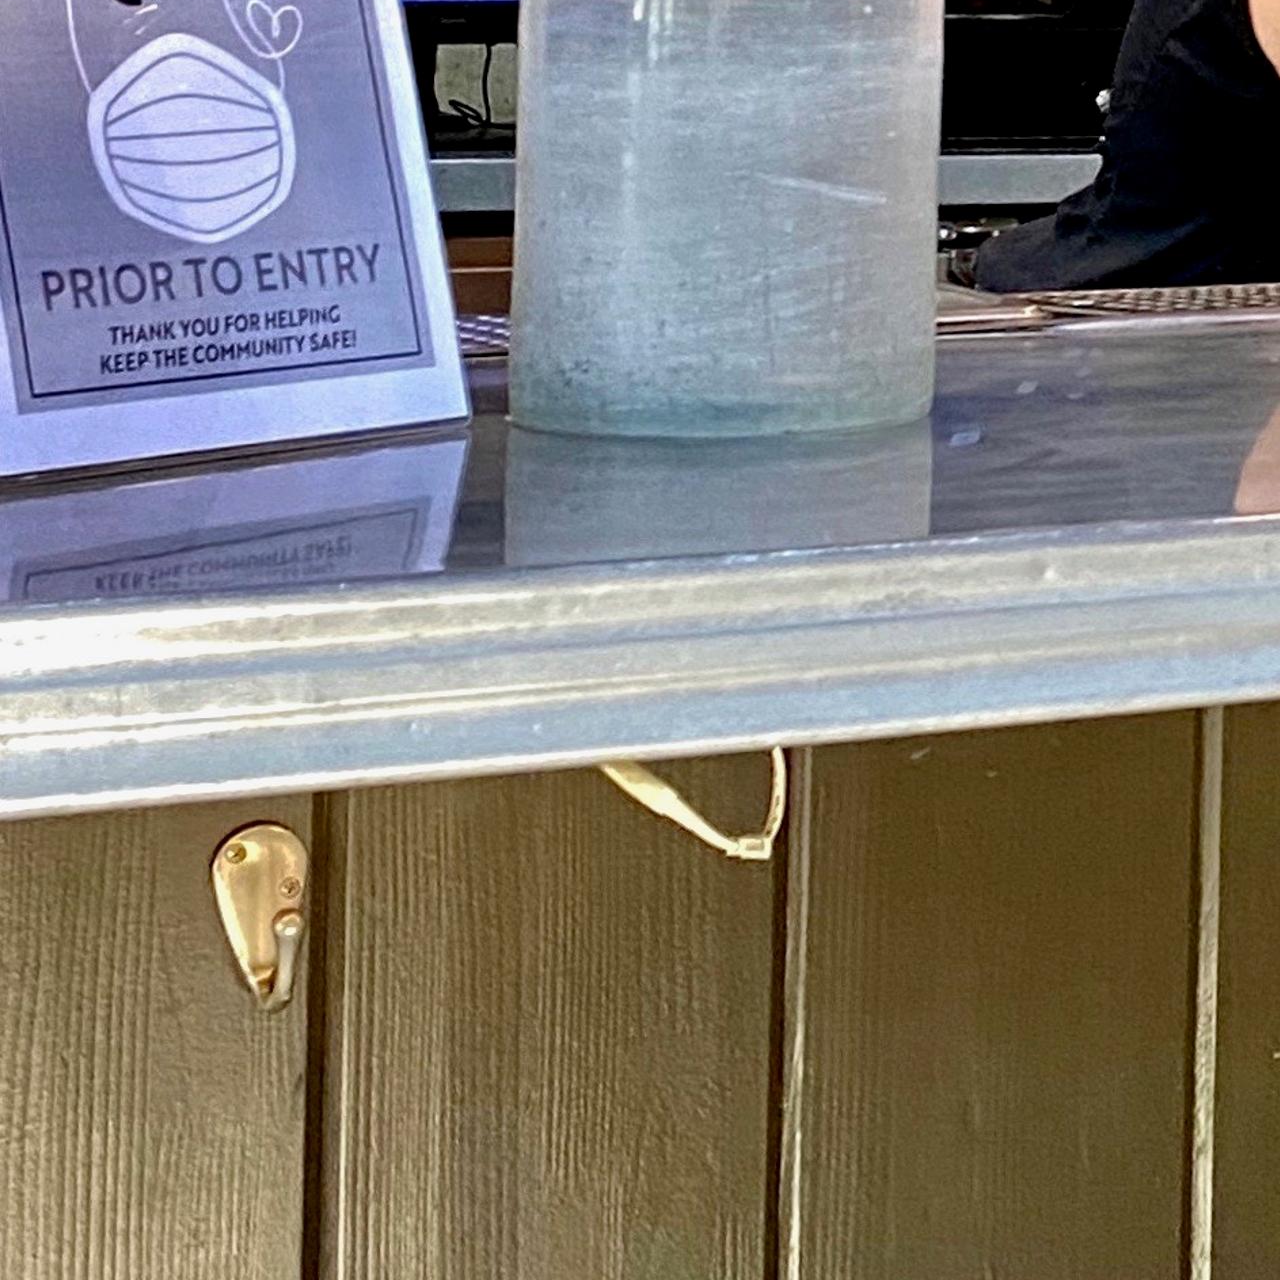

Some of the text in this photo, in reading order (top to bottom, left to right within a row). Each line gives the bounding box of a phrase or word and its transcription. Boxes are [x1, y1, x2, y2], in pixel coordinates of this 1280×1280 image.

[40, 242, 381, 312] PRIOR TO ENTRY
[108, 303, 342, 346] THANK YOU FOR HELPING
[99, 328, 358, 375] KEEP THE COMMUNITY SAFE!
